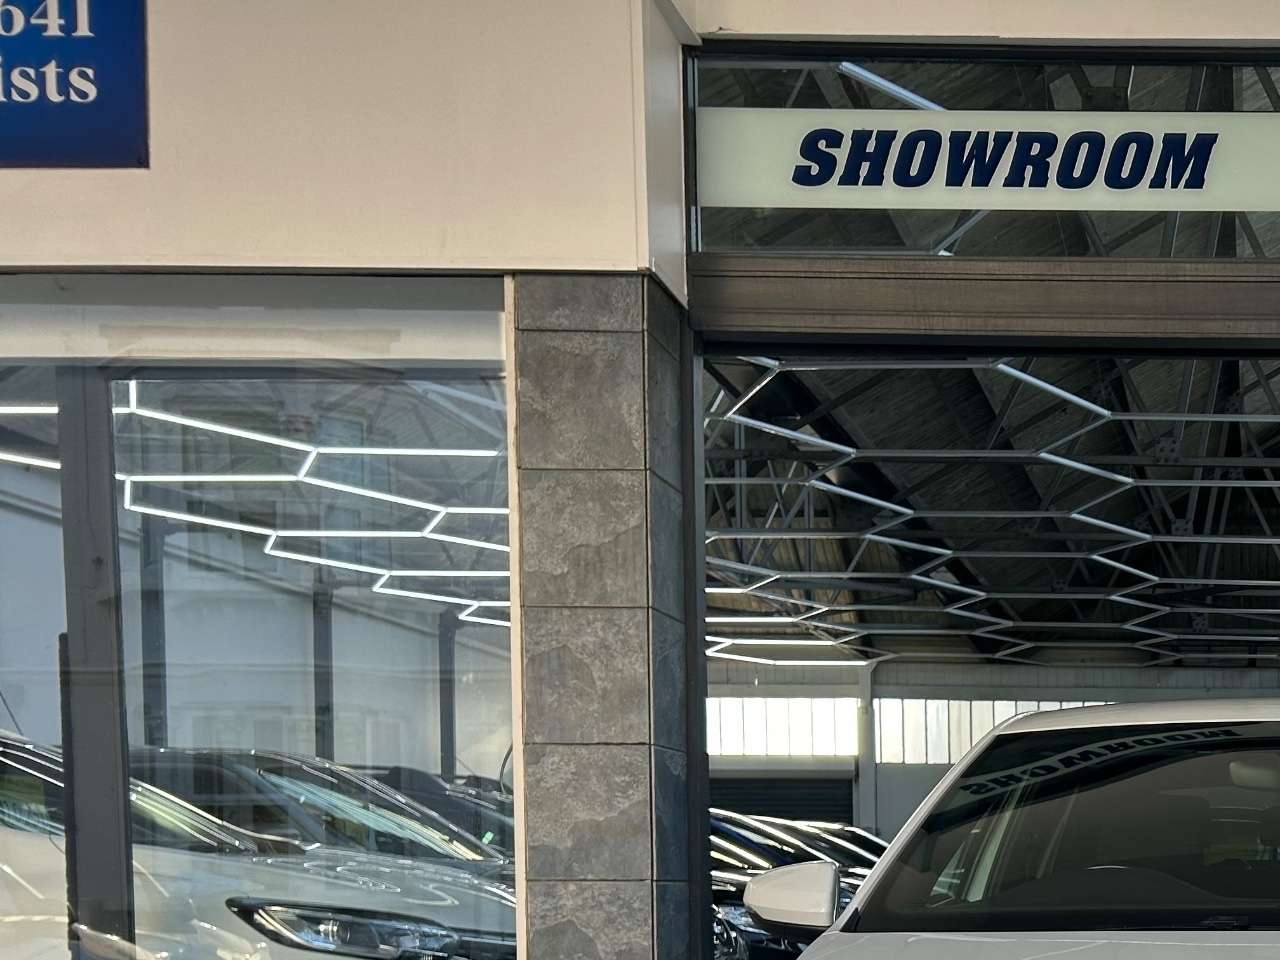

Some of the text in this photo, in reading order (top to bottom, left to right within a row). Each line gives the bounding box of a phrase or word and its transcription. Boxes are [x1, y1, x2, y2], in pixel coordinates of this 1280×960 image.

[0, 0, 95, 38] 641
[0, 56, 98, 103] sts
[791, 128, 1219, 190] SHOWROOM
